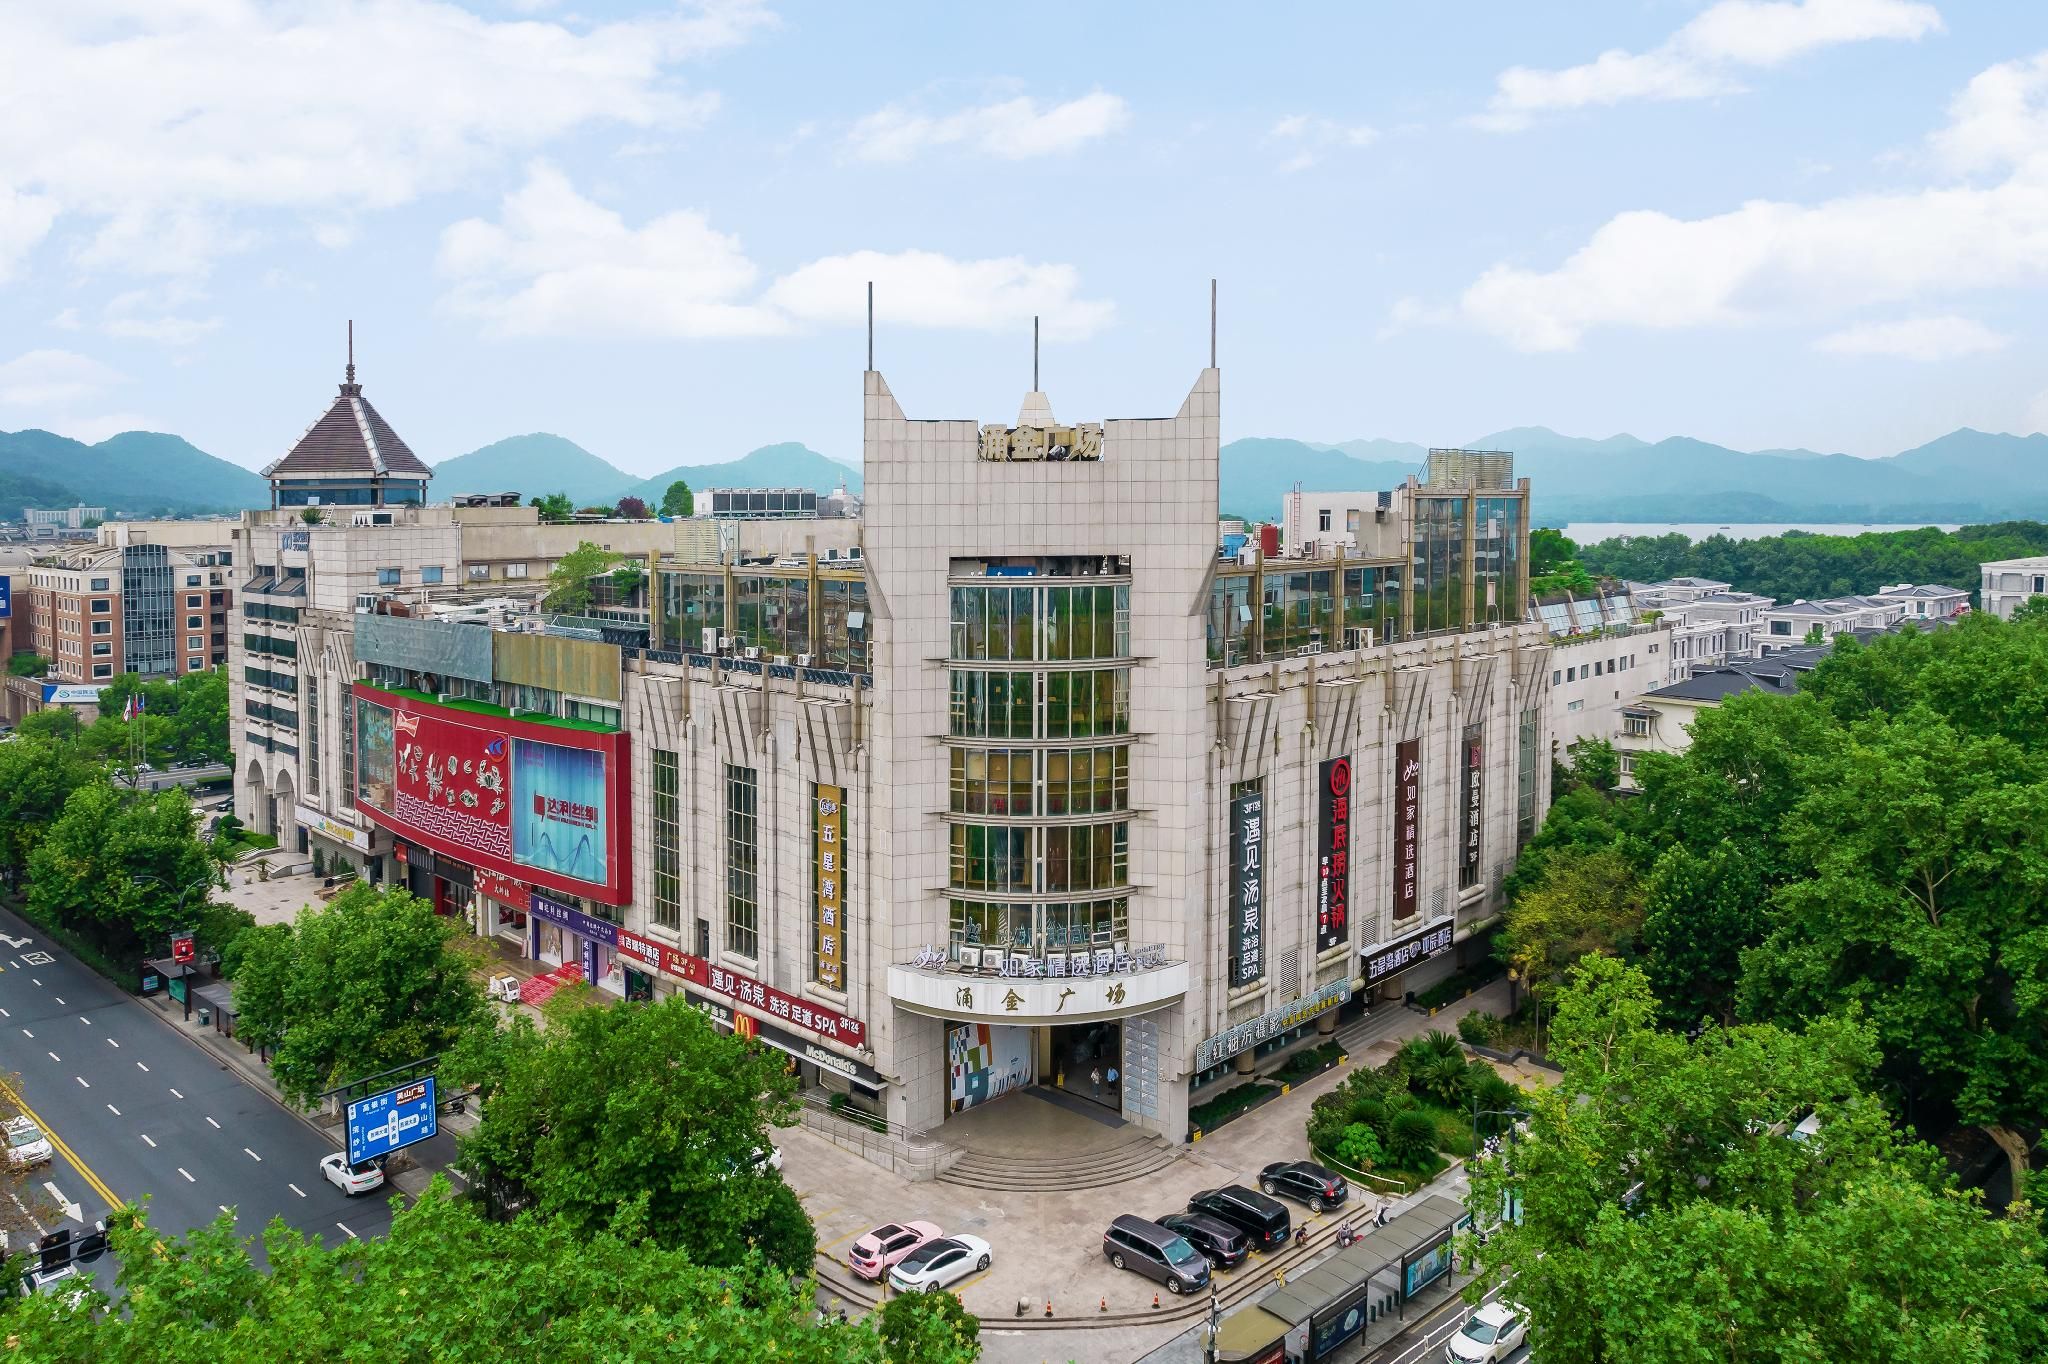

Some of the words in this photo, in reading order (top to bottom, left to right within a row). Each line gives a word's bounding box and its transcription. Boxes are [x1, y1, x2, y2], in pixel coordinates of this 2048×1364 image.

[981, 423, 1103, 461] 涌金广场
[1405, 785, 1416, 899] 如家精选酒店
[1330, 797, 1347, 929] 海底捞火锅
[822, 825, 837, 956] 五星湾酒店
[1241, 949, 1259, 966] 足道
[1242, 935, 1259, 951] 洗浴
[999, 951, 1131, 977] 如家精选酒店
[1241, 964, 1259, 980] SPA
[1369, 946, 1409, 979] 五星湾酒店
[956, 982, 1127, 1012] 涌金广场
[769, 996, 789, 1018] 洗浴
[792, 1005, 813, 1027] 足道
[815, 1014, 838, 1036] SPA
[806, 1045, 857, 1075] McDonald's
[397, 1085, 425, 1100] 吴山广场
[420, 1102, 429, 1134] 南山路
